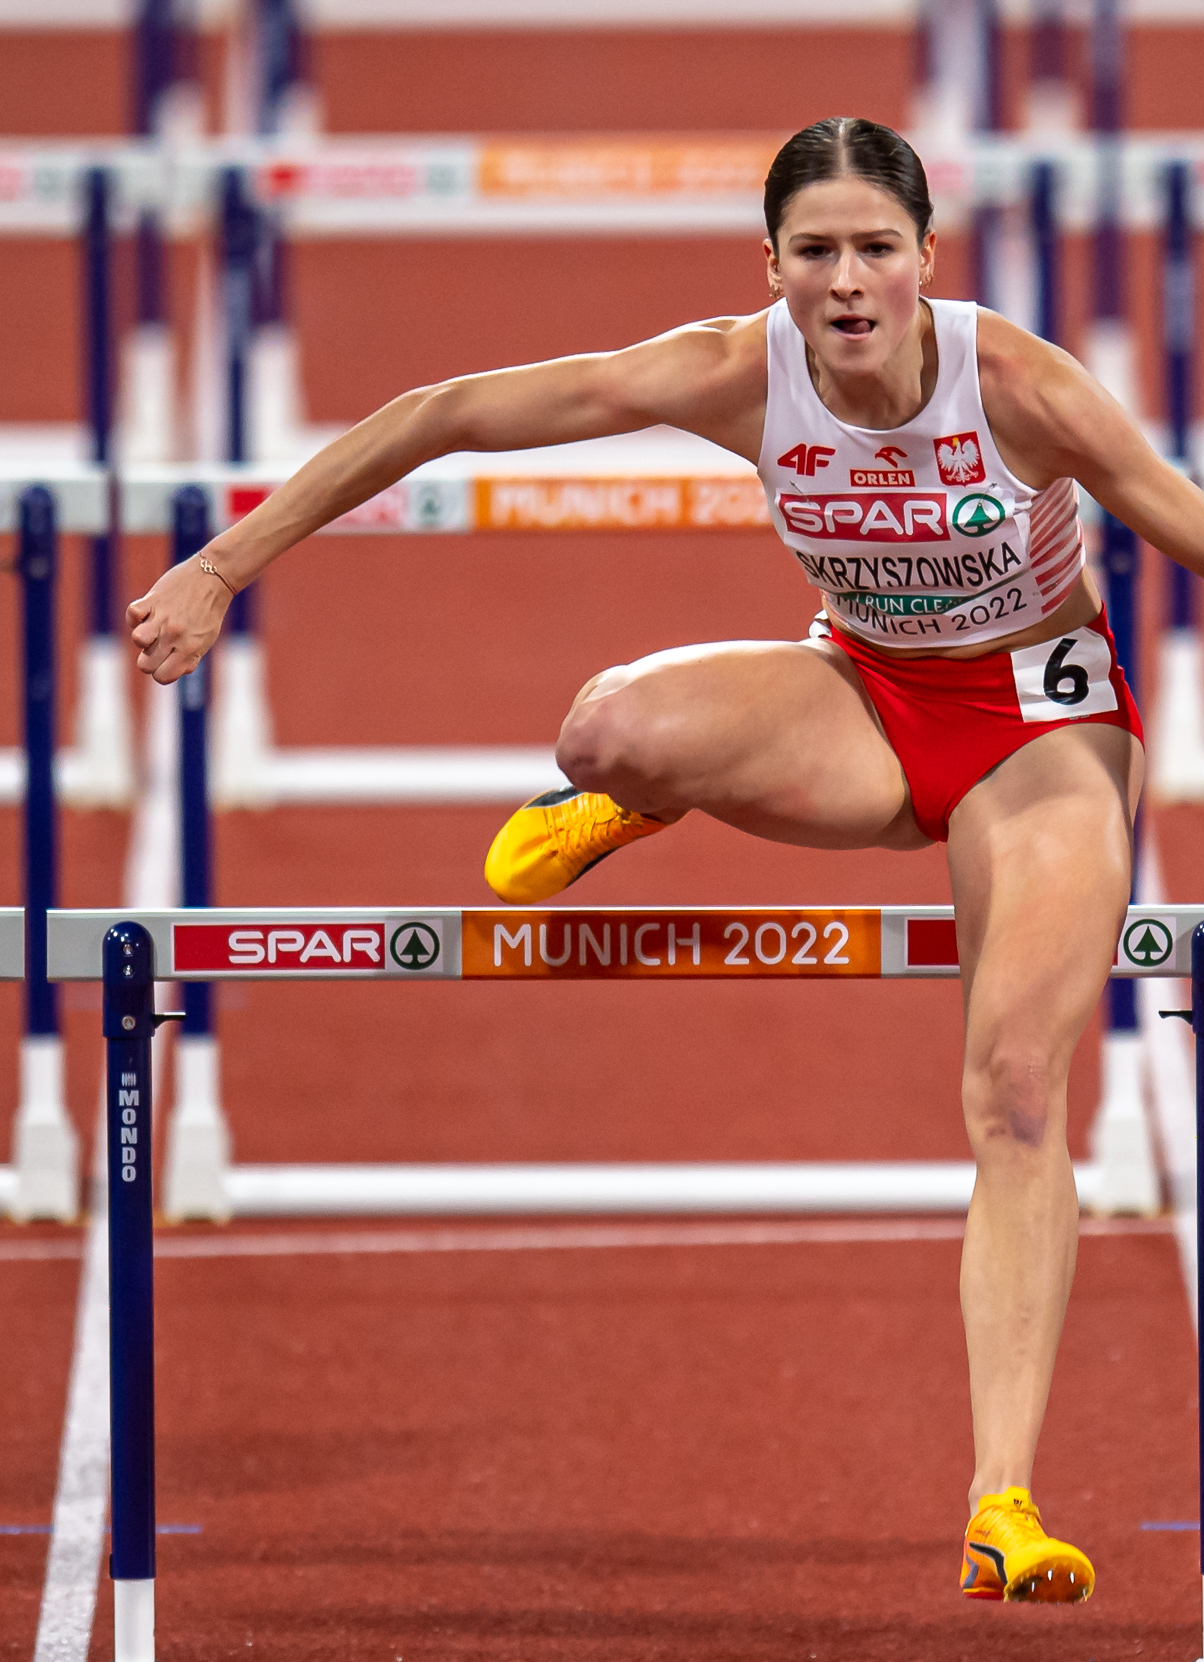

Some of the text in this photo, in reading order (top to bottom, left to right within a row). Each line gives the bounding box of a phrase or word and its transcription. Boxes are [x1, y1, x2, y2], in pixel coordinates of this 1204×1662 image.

[777, 443, 836, 476] 4F
[853, 472, 912, 486] ORLEN
[784, 500, 944, 536] SPAR
[796, 541, 1021, 590] SKRZYSZOWSKA
[865, 594, 904, 613] RUN
[951, 588, 1027, 631] 2022
[1043, 638, 1090, 706] 6
[228, 922, 850, 967] SPAR MUNICH 2022
[119, 1090, 139, 1182] MONDO
